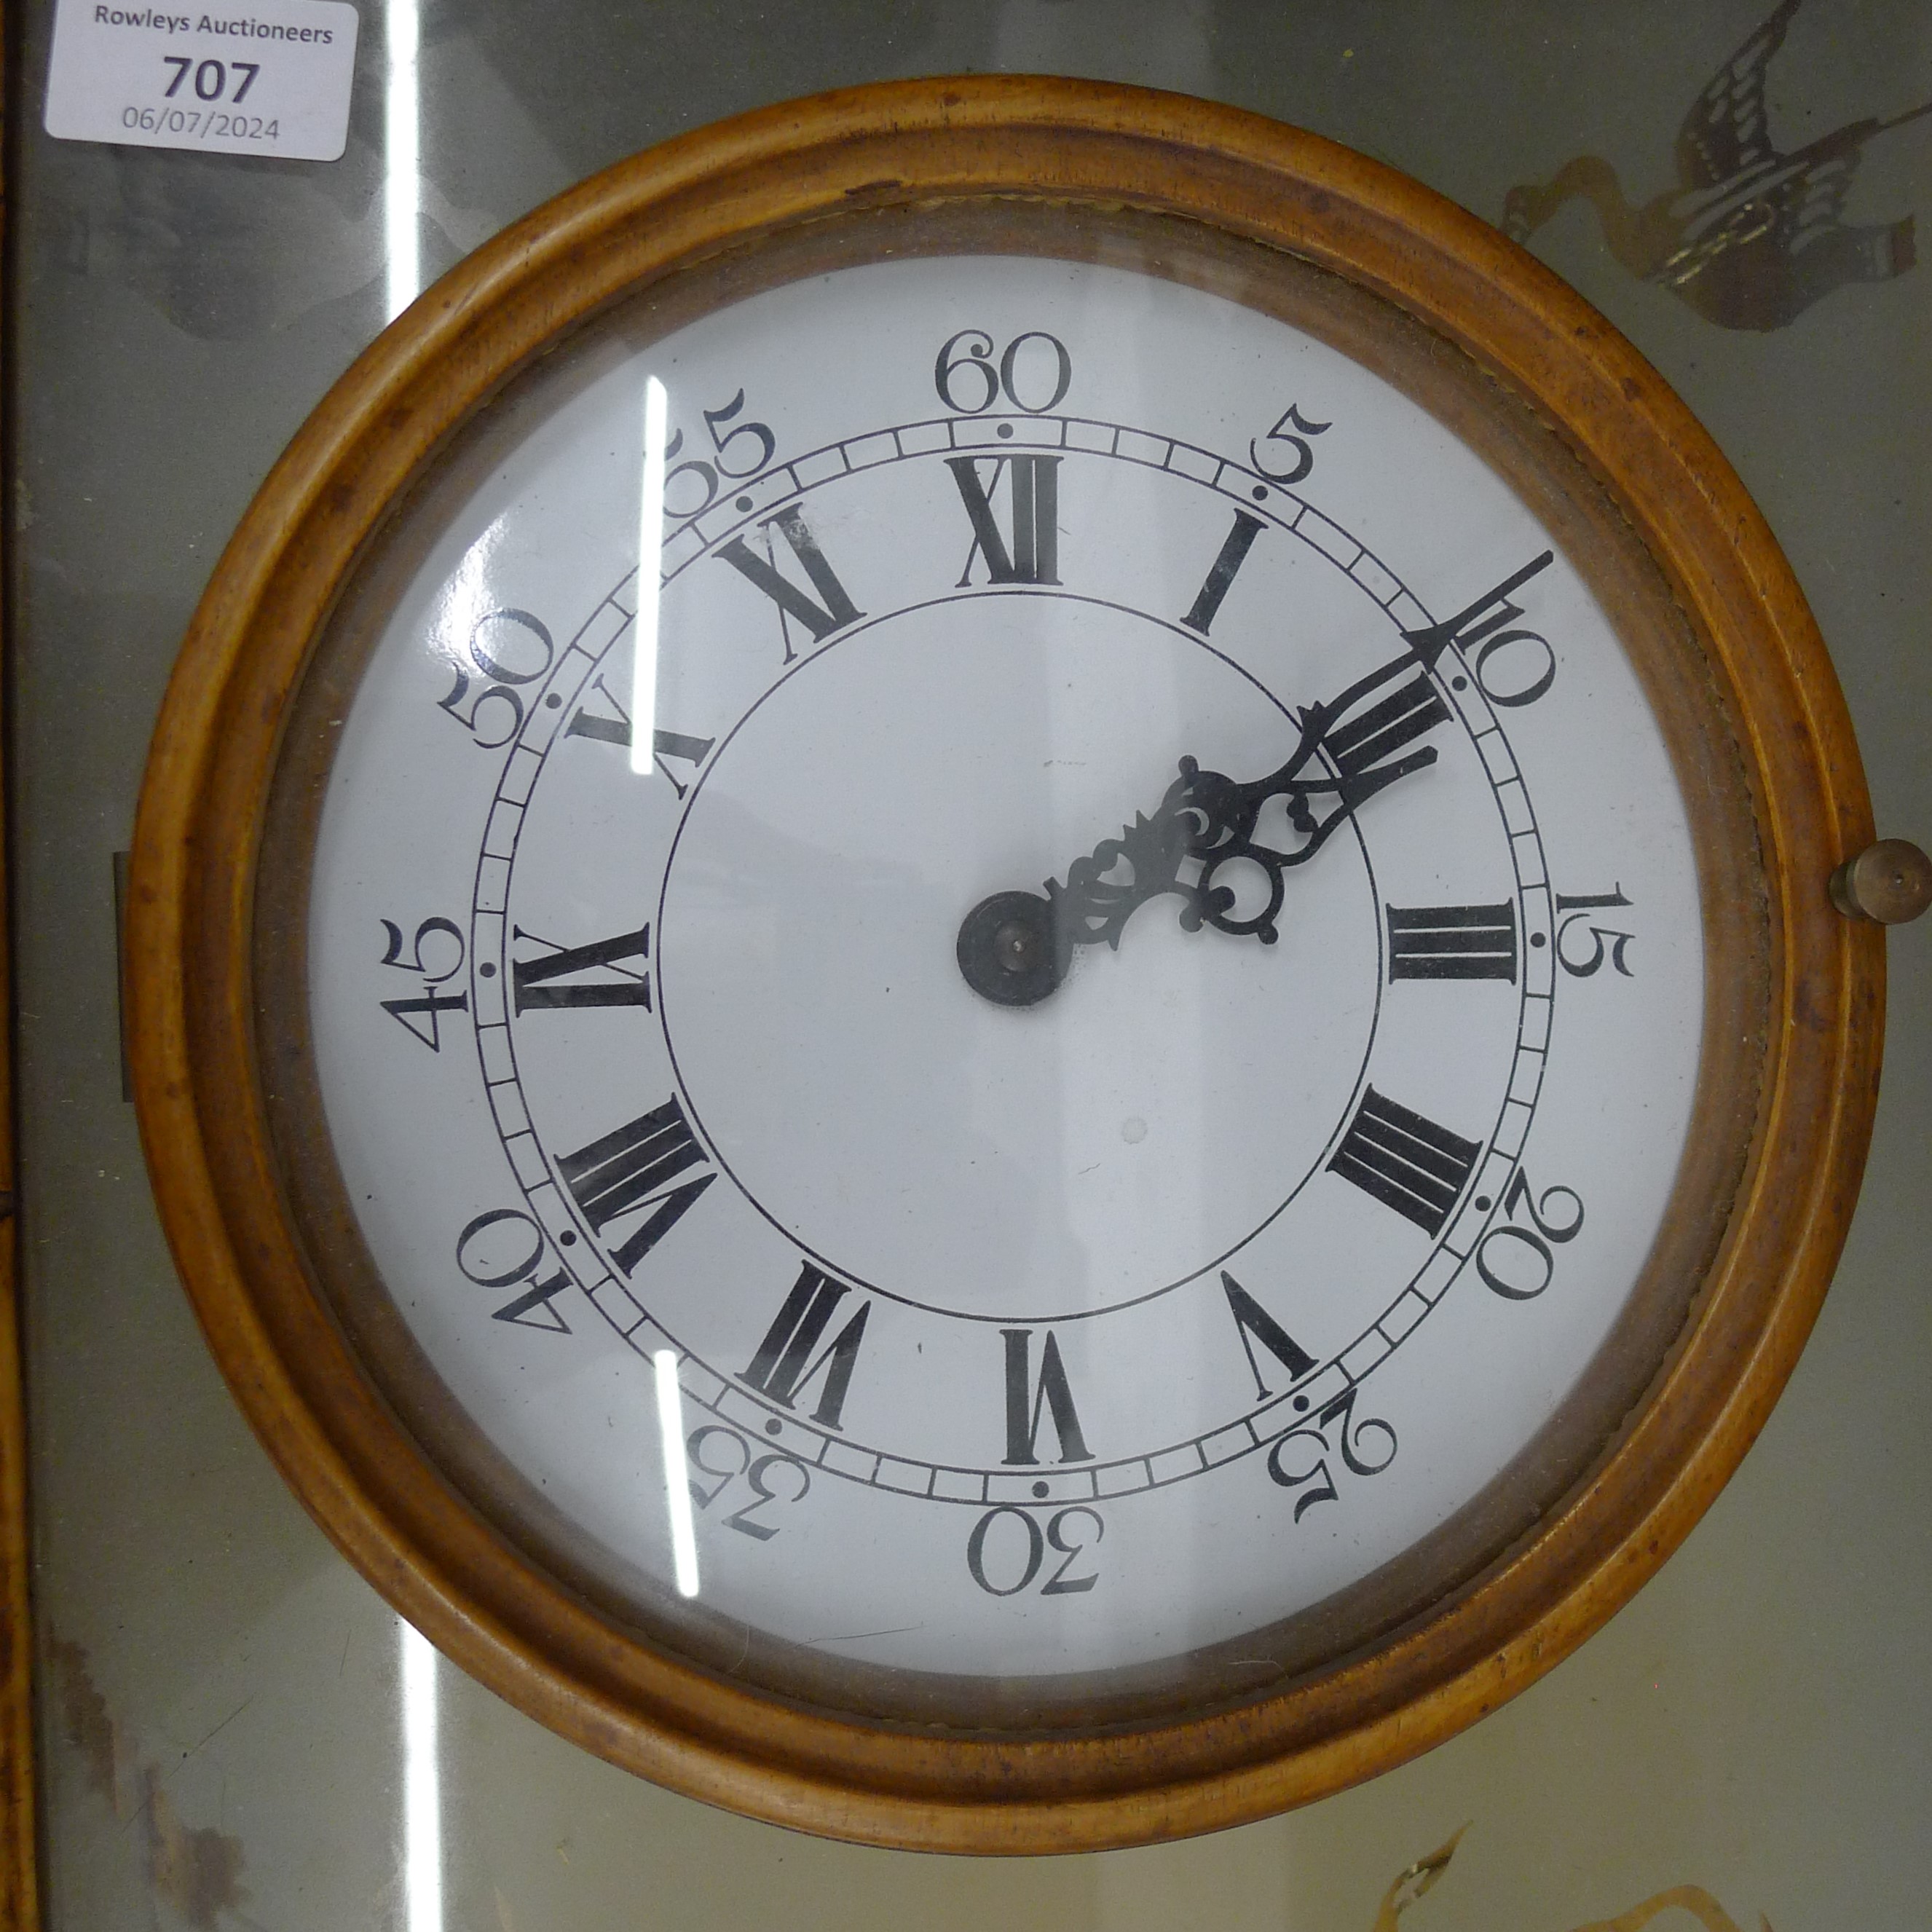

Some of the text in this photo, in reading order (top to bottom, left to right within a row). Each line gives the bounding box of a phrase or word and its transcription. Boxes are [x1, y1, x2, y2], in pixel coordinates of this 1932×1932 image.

[95, 5, 334, 44] Rowleys Auctioneers
[163, 56, 261, 104] 707
[122, 106, 281, 140] 06/07/2024
[934, 329, 1071, 414] 60
[644, 388, 776, 518] 55
[1250, 403, 1333, 484] 5
[712, 502, 867, 664] XI
[944, 454, 1064, 588] XII
[1179, 508, 1269, 636] I
[437, 607, 553, 749] 50
[1455, 597, 1556, 708] 10
[565, 674, 715, 800] X
[1318, 670, 1454, 776] II
[379, 916, 468, 1052] 45
[512, 922, 652, 1018] IX
[1386, 897, 1517, 986] III
[1556, 881, 1636, 977] 15
[553, 1092, 717, 1279] VIII
[1325, 1083, 1483, 1240] IIII
[456, 1208, 574, 1334] 40
[1475, 1166, 1585, 1301] 20
[734, 1259, 871, 1431] VII
[999, 1330, 1096, 1464] VI
[1221, 1270, 1319, 1401] V
[666, 1424, 811, 1541] 35
[1268, 1389, 1397, 1523] 25
[967, 1505, 1104, 1596] 30
